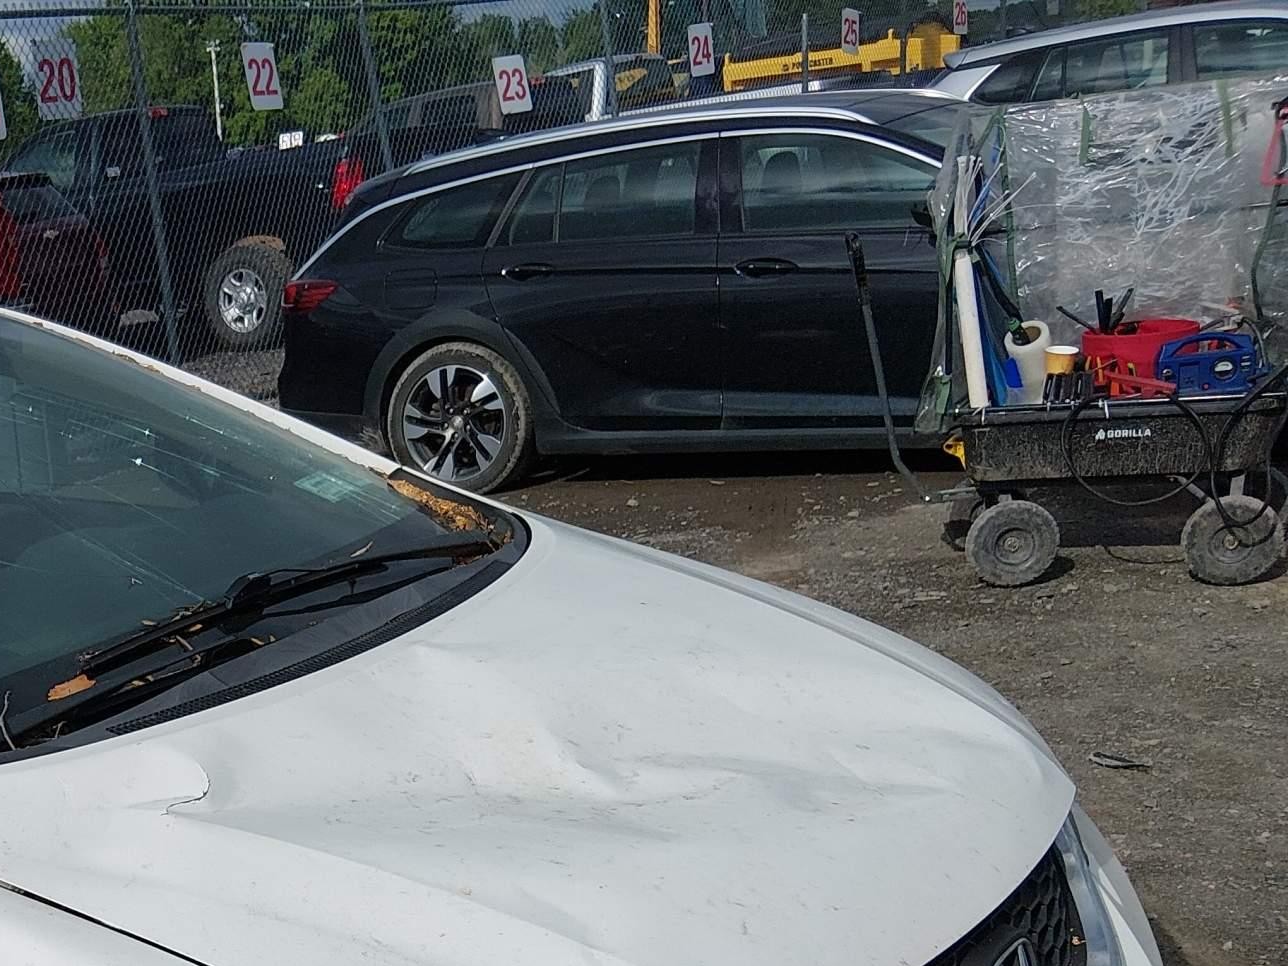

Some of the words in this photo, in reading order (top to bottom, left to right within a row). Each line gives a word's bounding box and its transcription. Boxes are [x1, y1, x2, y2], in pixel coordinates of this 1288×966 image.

[955, 2, 967, 26] 26
[844, 17, 857, 47] 25
[692, 35, 712, 66] 24
[38, 57, 77, 104] 20
[248, 58, 278, 96] 22
[499, 68, 527, 102] 23
[1107, 428, 1152, 438] GORILLA
